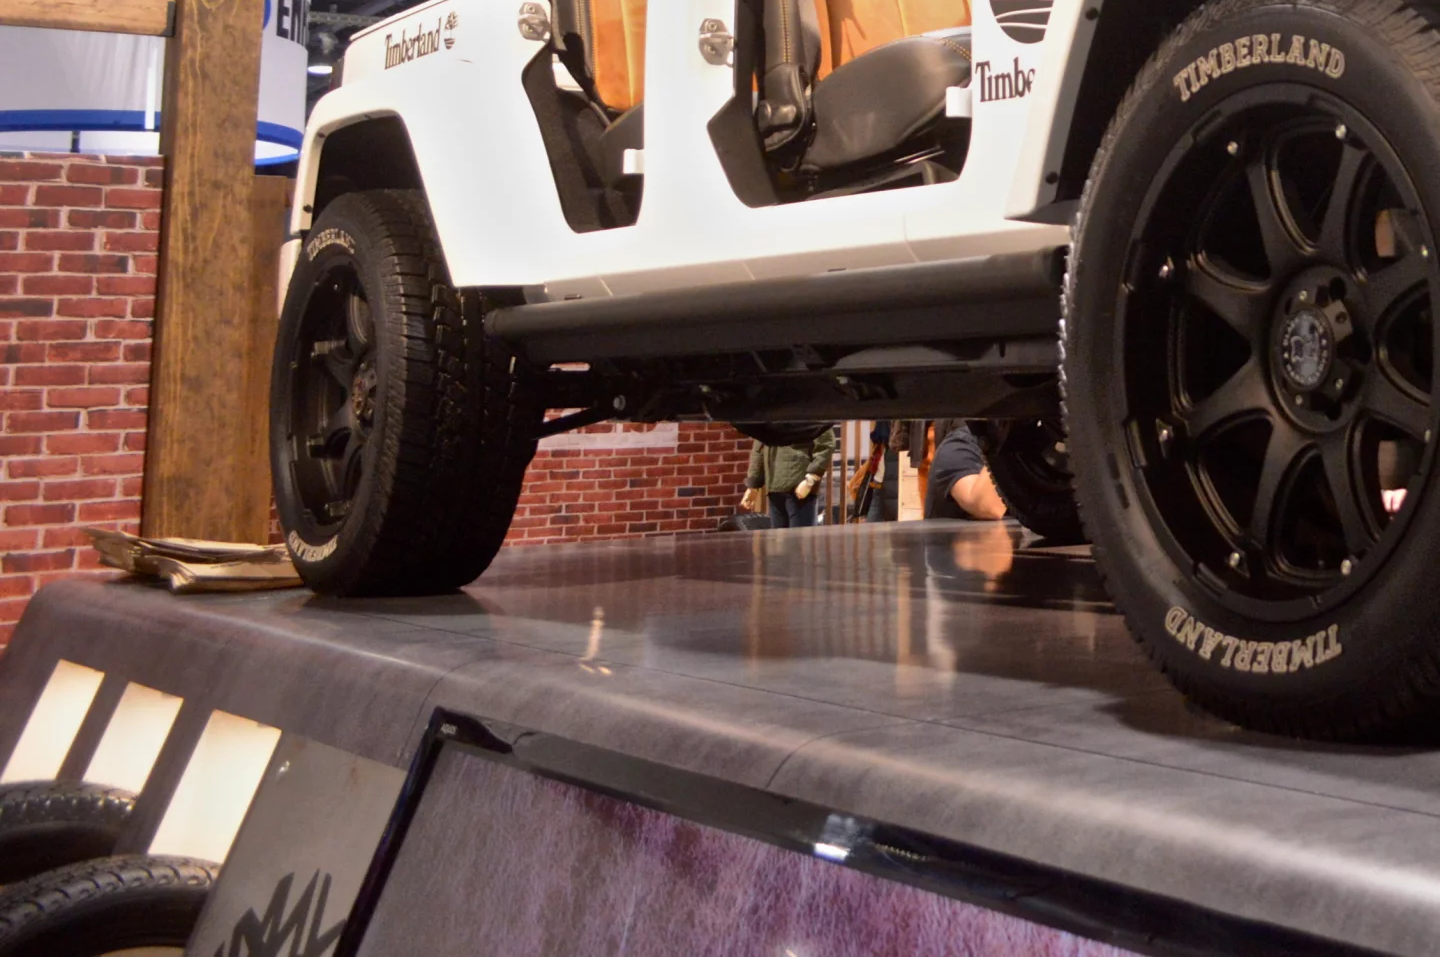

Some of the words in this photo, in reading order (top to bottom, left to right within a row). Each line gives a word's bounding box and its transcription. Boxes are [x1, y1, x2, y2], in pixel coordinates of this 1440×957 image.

[384, 14, 441, 70] Timberland
[1174, 33, 1346, 102] TIMBERLAND
[1164, 604, 1343, 673] TIMBERLAND
